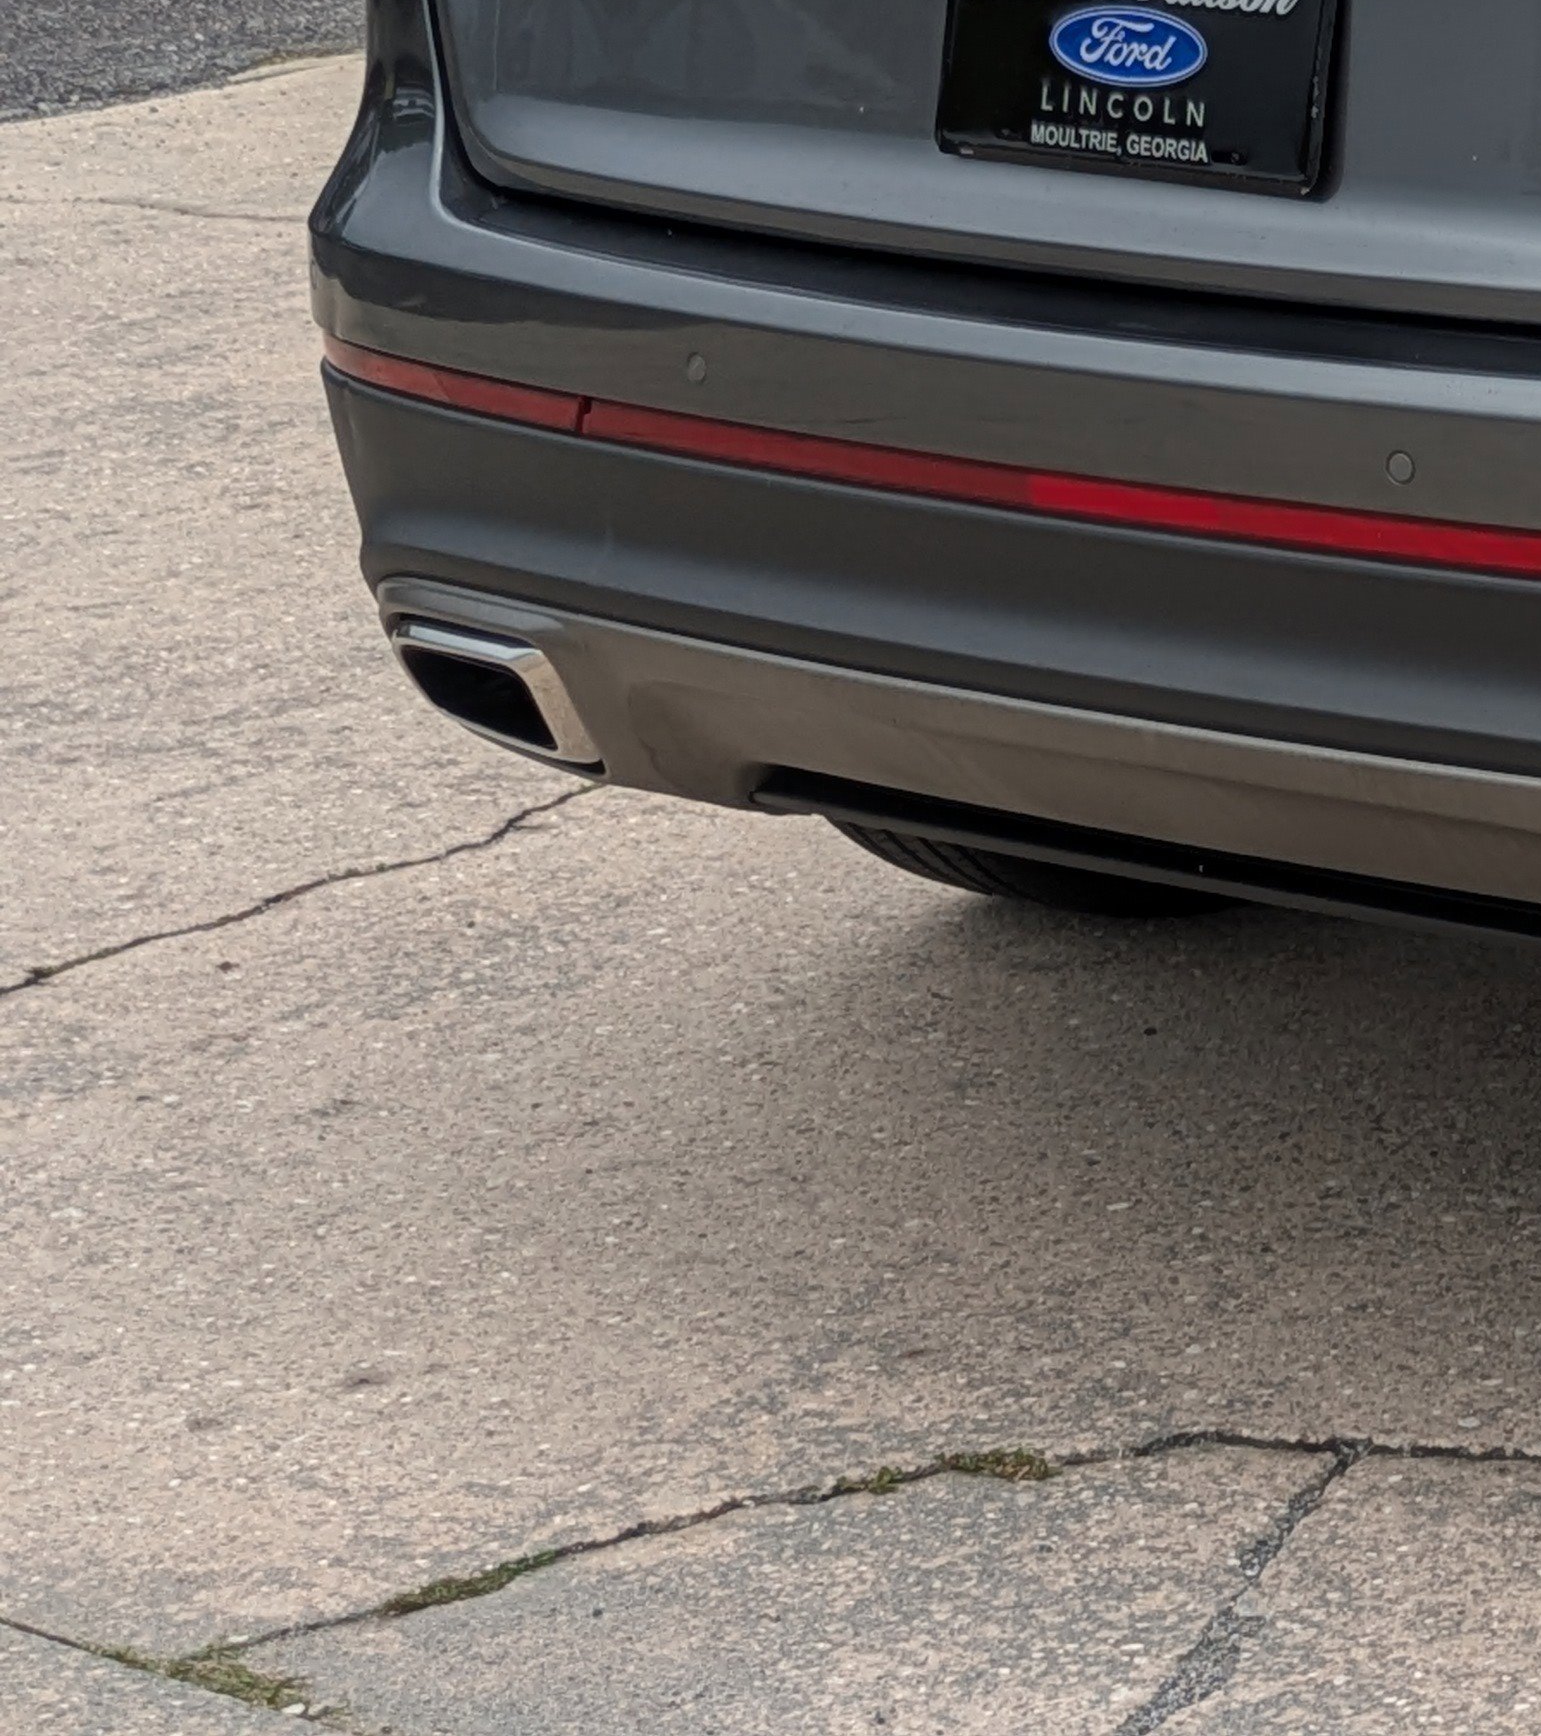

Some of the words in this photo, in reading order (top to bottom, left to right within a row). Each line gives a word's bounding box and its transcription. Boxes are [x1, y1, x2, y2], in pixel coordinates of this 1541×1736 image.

[1079, 16, 1176, 71] Ford
[1039, 79, 1206, 127] LINCOLN
[1030, 122, 1123, 156] MOULTRIE,
[1125, 135, 1208, 164] GEORGIA
